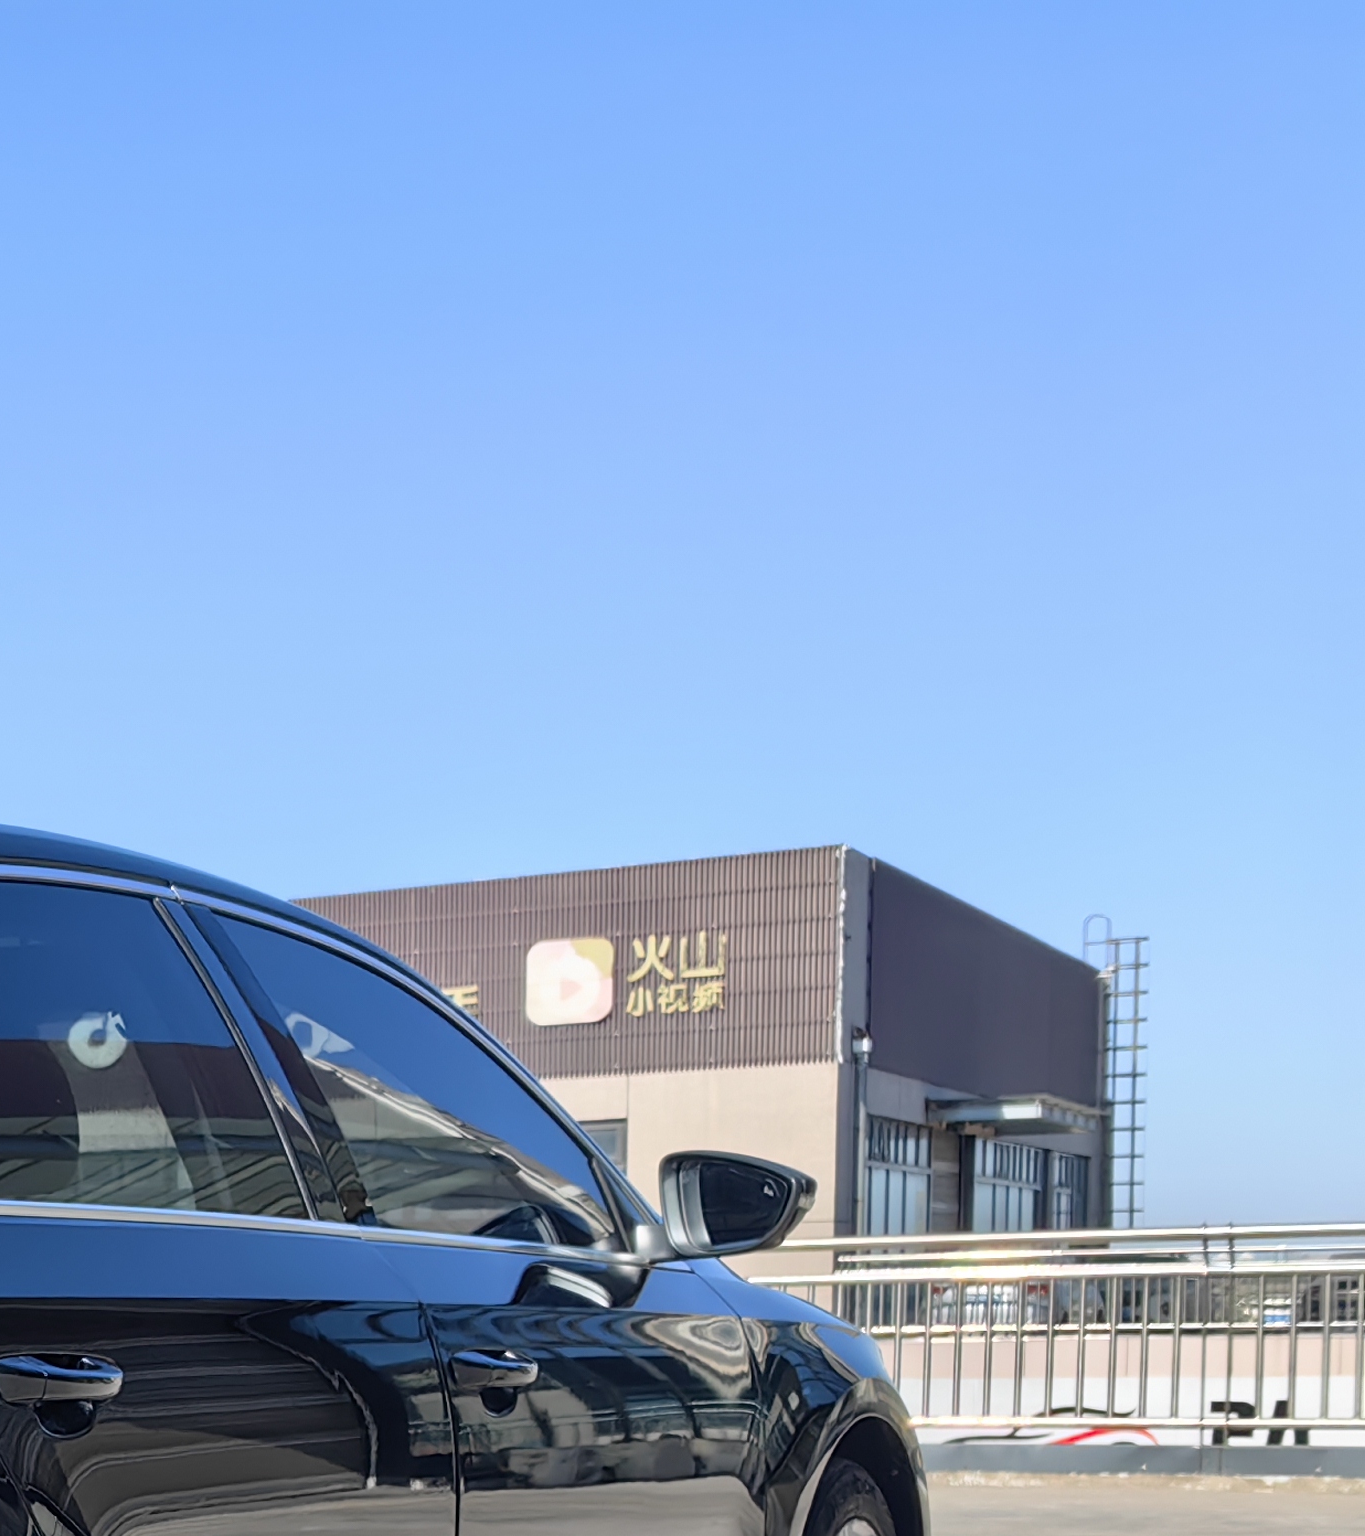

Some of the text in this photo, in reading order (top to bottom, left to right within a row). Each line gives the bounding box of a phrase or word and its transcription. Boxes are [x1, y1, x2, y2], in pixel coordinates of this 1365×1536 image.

[627, 930, 727, 983] 火山
[626, 981, 725, 1018] 小视频
